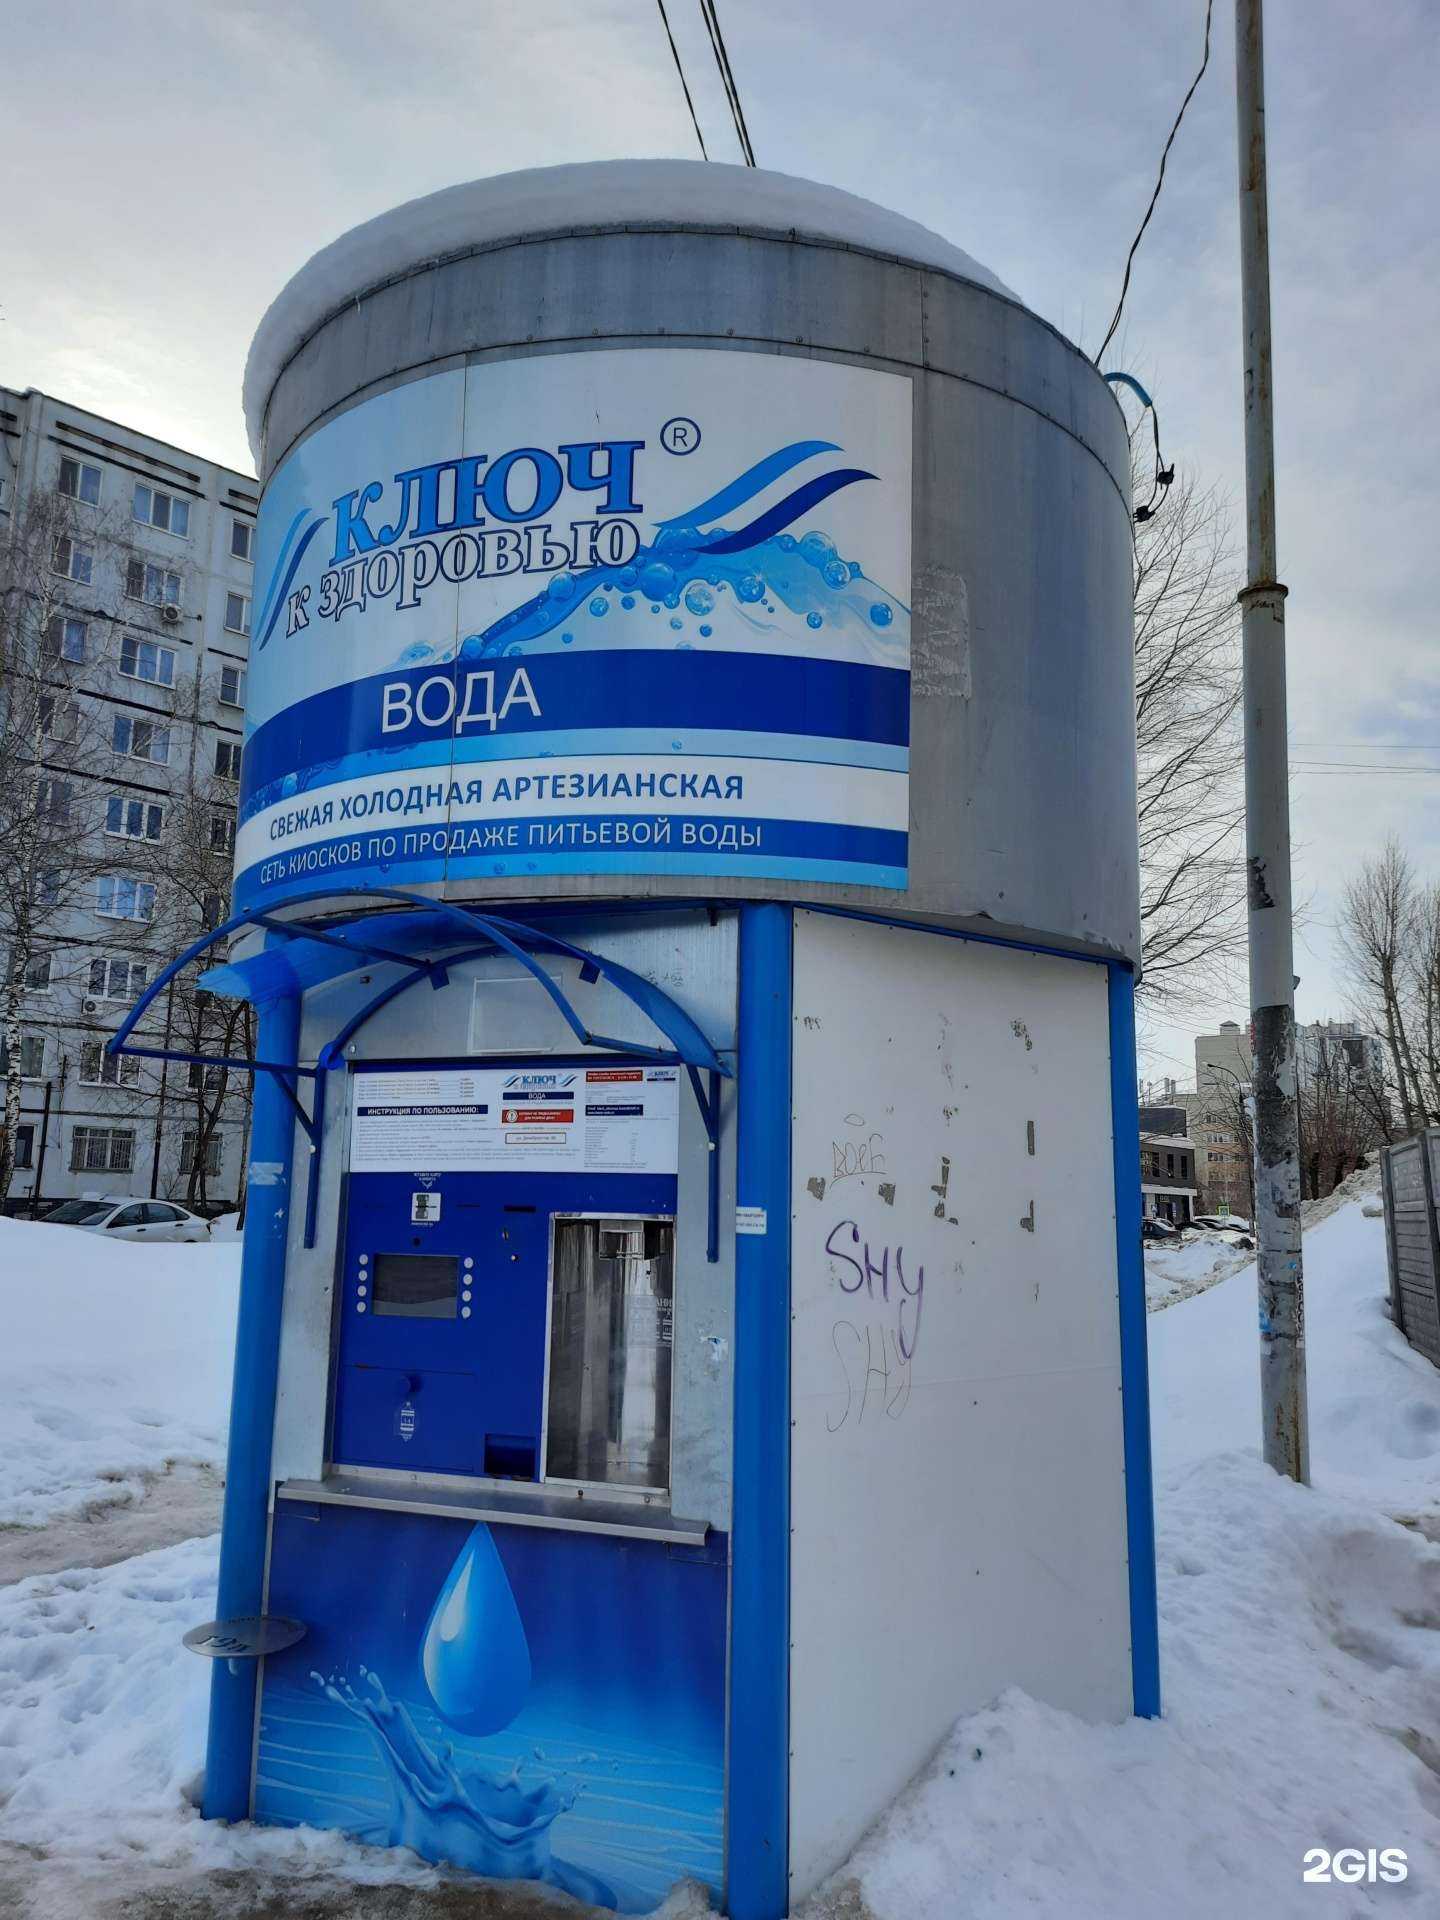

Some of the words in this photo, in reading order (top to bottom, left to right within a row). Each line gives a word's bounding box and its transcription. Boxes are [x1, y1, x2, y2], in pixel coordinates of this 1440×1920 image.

[328, 441, 646, 567] КЛЮЧ
[381, 667, 542, 735] ВОДА
[270, 801, 333, 841] СВЕЖАЯ
[340, 780, 482, 821] ХОЛОДНАЯ
[492, 773, 744, 802] АРТЕЗИАНСКАЯ
[260, 862, 286, 885] СЕТЬ
[289, 841, 362, 876] КИОСКОВ
[368, 836, 397, 859] ПО
[404, 826, 519, 855] ПРОДАЖЕ
[528, 817, 671, 847] ПИТЬЕВОЙ
[682, 823, 762, 851] ВОДЫ
[367, 1107, 411, 1116] ИНСТРУКЦИЯ
[412, 1107, 423, 1115] ПО
